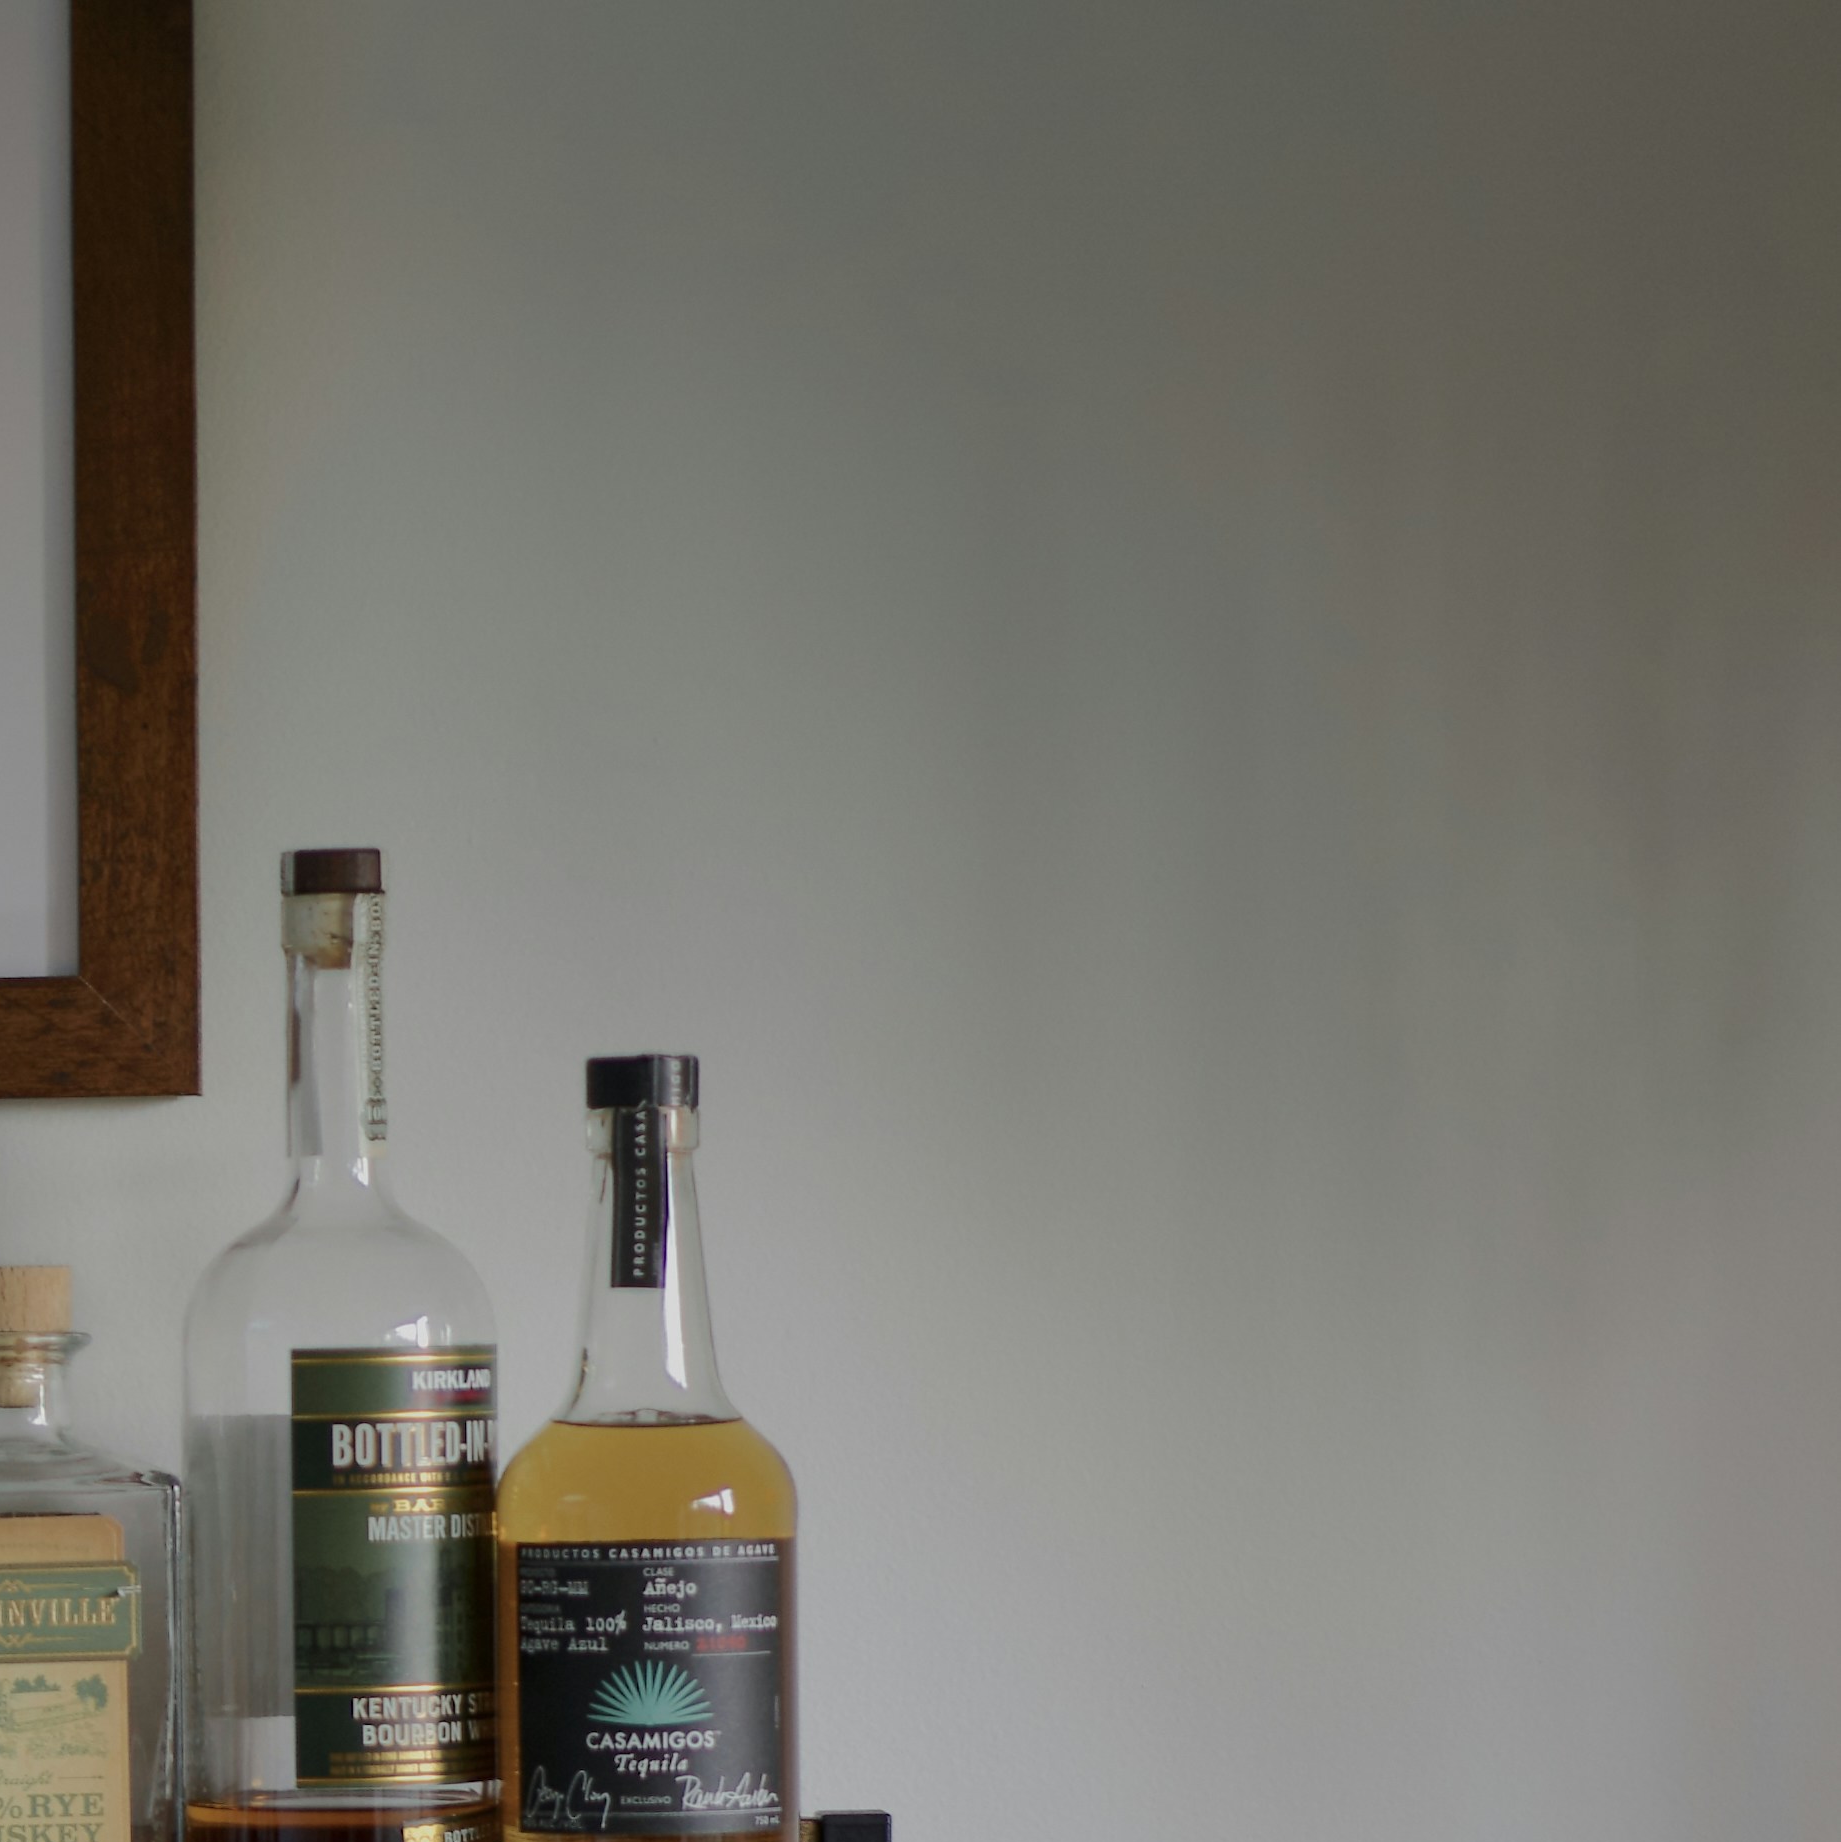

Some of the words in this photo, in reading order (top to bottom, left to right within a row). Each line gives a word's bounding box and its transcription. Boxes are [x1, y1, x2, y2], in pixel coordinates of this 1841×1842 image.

[632, 1167, 647, 1277] PRODUCTOS
[412, 1368, 491, 1391] KIRKLAND
[367, 1514, 446, 1542] MASTER
[521, 1548, 600, 1560] PRODUCTOS
[608, 1546, 705, 1559] CASAMIGOS
[712, 1545, 730, 1557] DE
[737, 1543, 776, 1556] AGAVE
[642, 1567, 675, 1577] CLASE
[642, 1578, 698, 1600] Añejo
[643, 1603, 681, 1613] HECHO
[520, 1618, 575, 1632] Tequila
[585, 1610, 627, 1636] 100%
[642, 1617, 723, 1634] Jalisco,
[730, 1613, 778, 1629] Mexico
[520, 1639, 560, 1655] Agave
[566, 1637, 609, 1652] Azul
[643, 1641, 691, 1651] NUMERO
[352, 1693, 463, 1720] KENTUCKY
[362, 1720, 463, 1747] BOURBON
[586, 1731, 716, 1752] CASAMIGOS
[614, 1752, 690, 1779] Tequila
[27, 1793, 105, 1818] RYE
[620, 1795, 672, 1806] EXCLUSIVO
